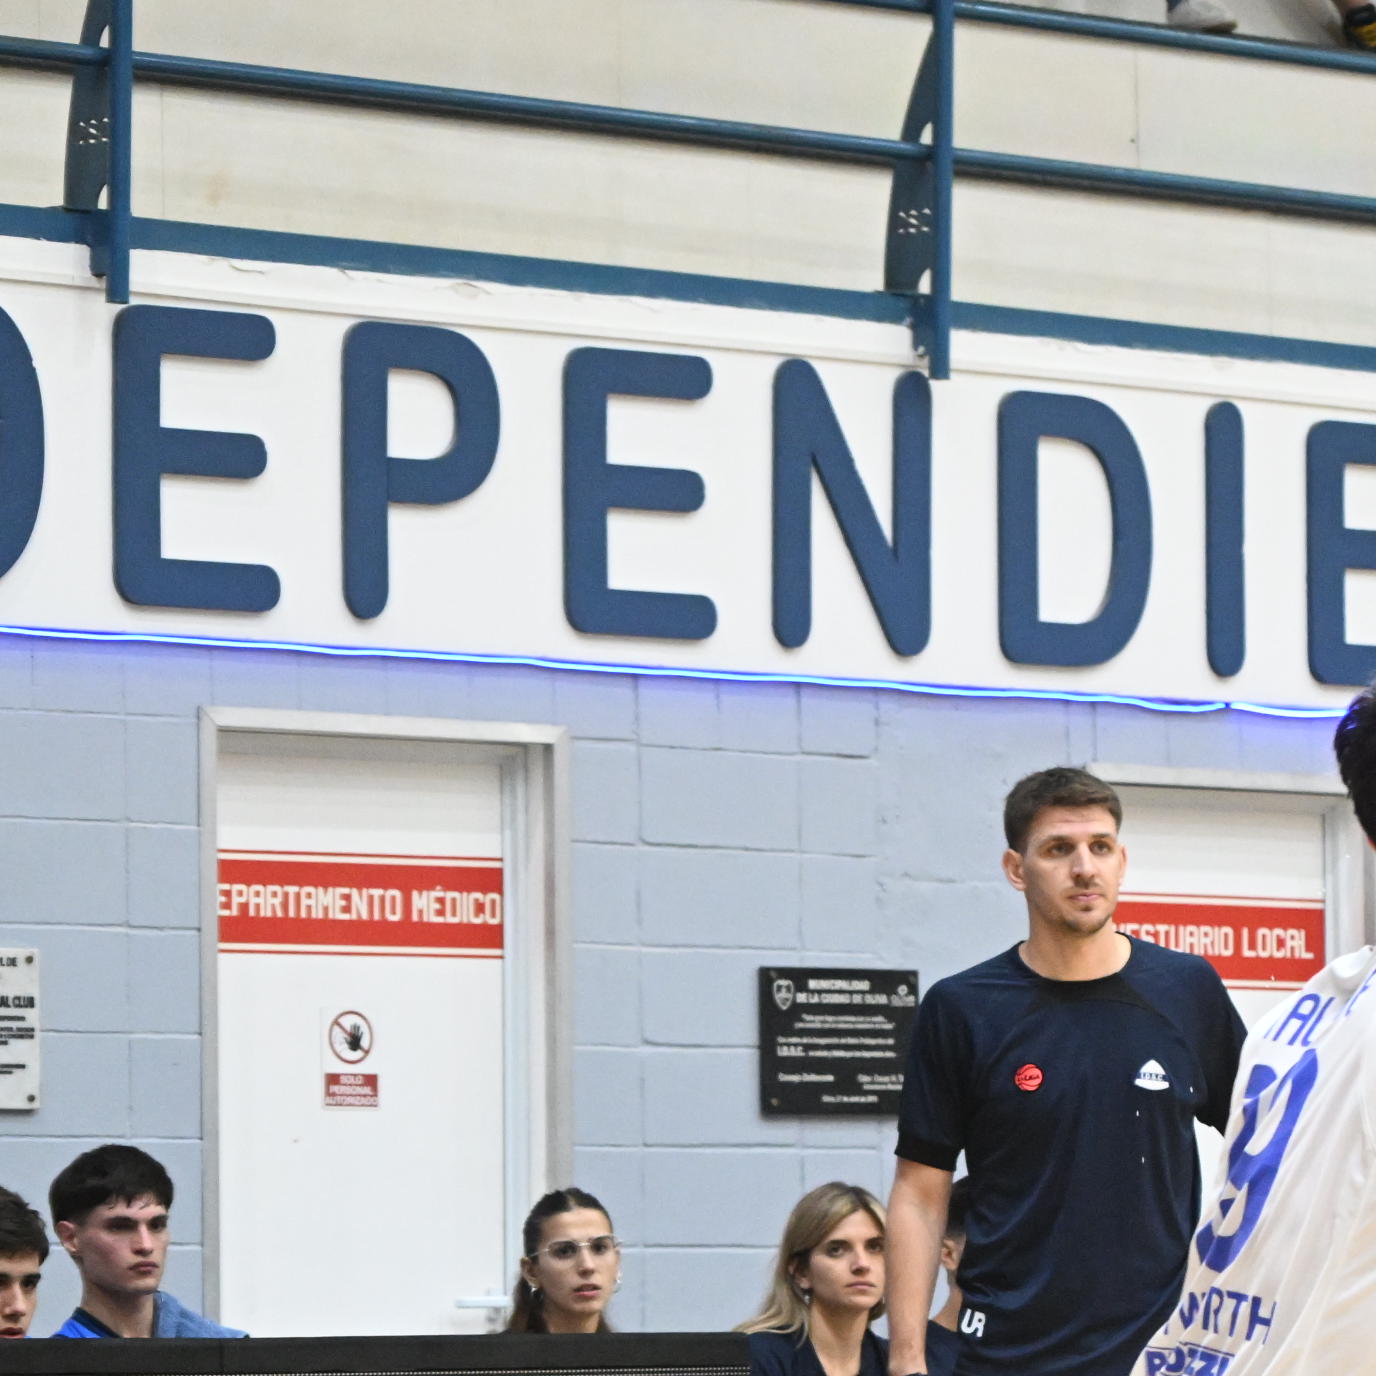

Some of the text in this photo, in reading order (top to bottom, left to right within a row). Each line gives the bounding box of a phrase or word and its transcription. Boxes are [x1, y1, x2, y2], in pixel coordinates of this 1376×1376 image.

[216, 882, 502, 925] EPARTAMENTO MÉDICO
[1241, 926, 1315, 960] LOCAL
